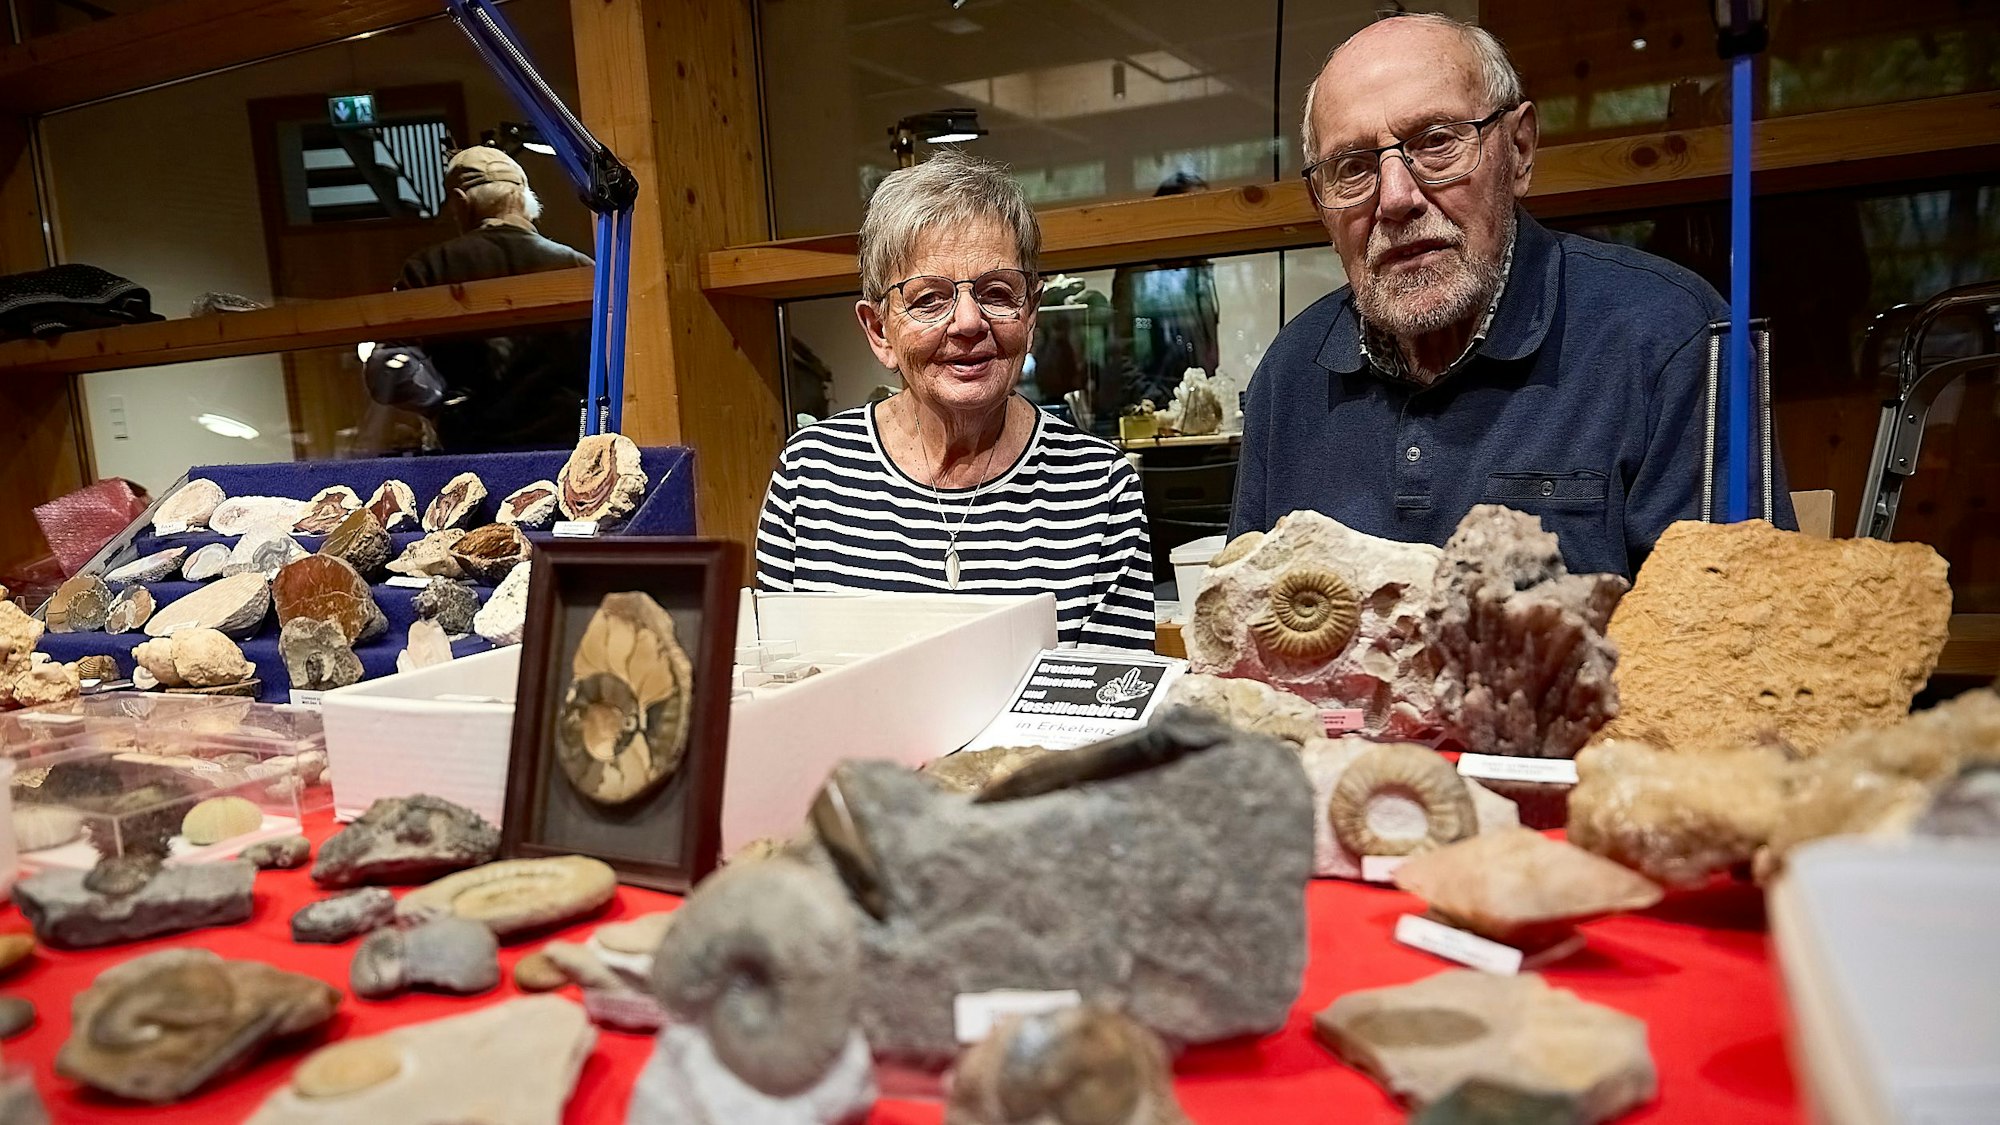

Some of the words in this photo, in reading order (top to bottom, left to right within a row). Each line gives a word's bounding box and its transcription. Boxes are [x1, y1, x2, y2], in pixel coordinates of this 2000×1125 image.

[1022, 690, 1048, 699] und
[1013, 699, 1138, 719] Fossilienbörse
[1016, 720, 1031, 729] in
[1037, 721, 1117, 736] Erkelenz
